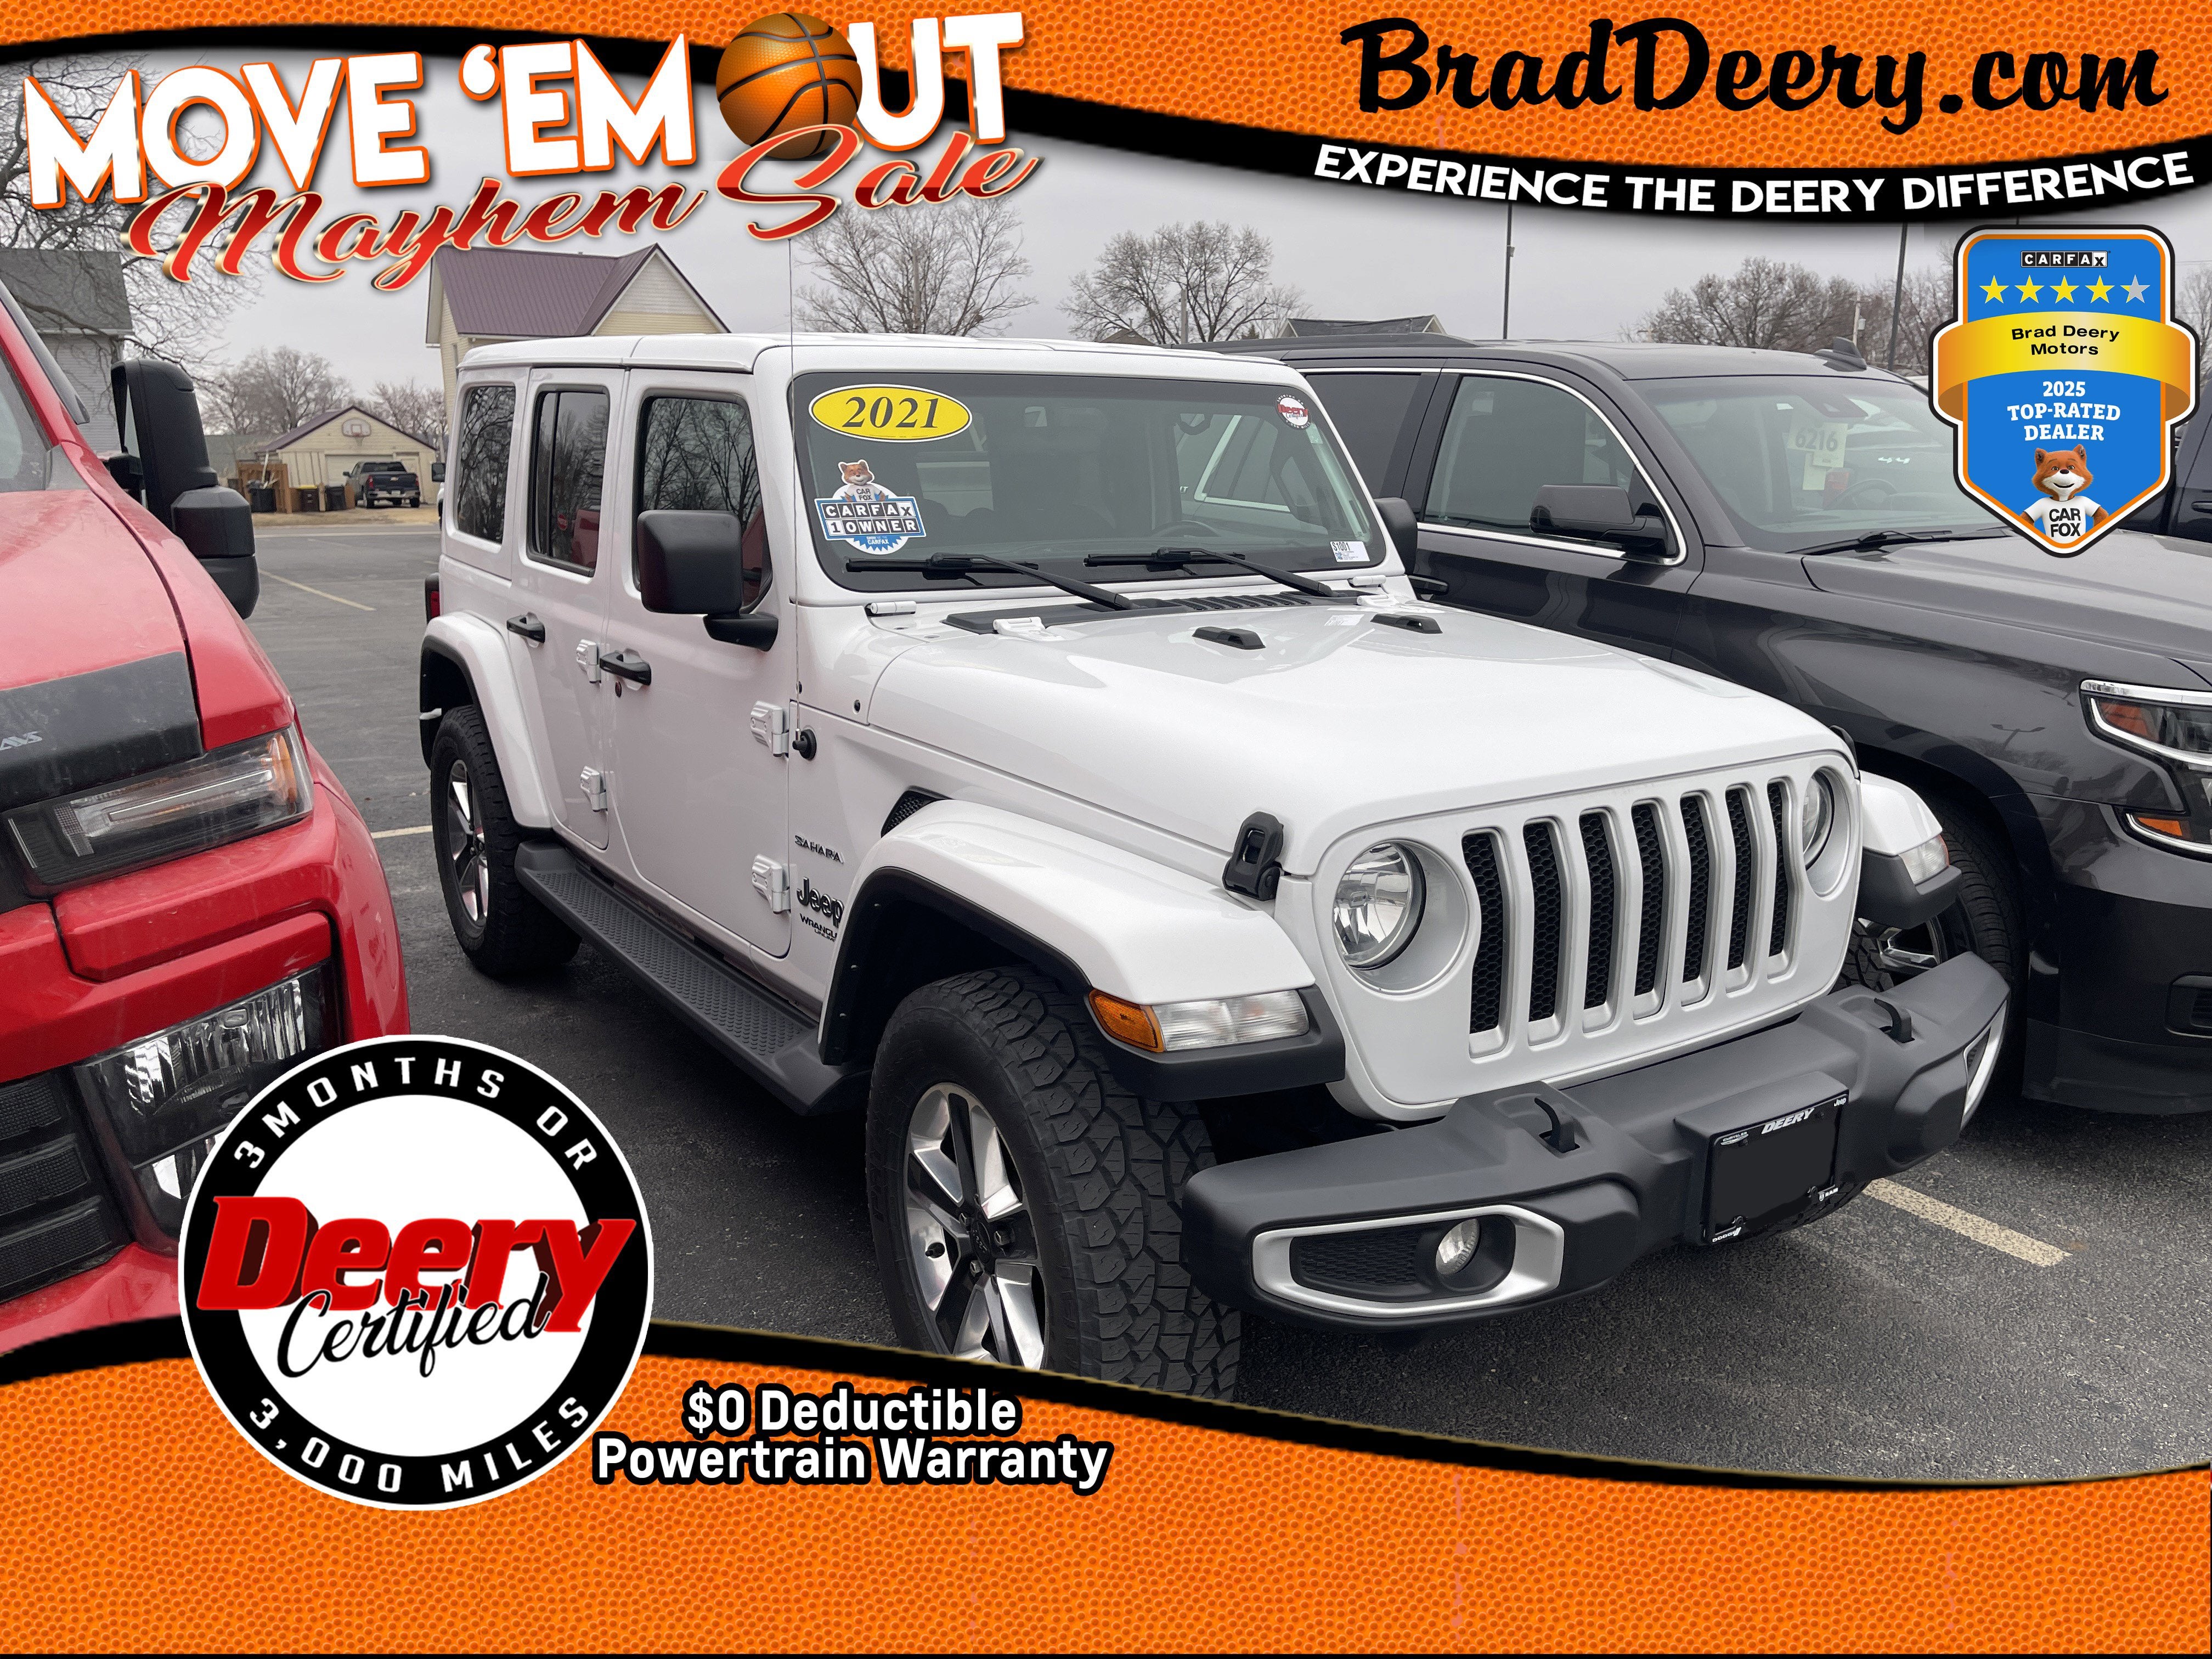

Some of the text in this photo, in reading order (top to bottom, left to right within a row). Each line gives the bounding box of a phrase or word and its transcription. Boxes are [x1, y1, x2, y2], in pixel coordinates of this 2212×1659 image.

[842, 397, 939, 428] 2021
[1795, 428, 1837, 451] 6216
[826, 504, 913, 517] CARFAX
[794, 834, 845, 864] SAHARA
[797, 877, 844, 928] Jeep
[1761, 1108, 1815, 1135] DEERY
[1825, 1187, 1838, 1197] RAM
